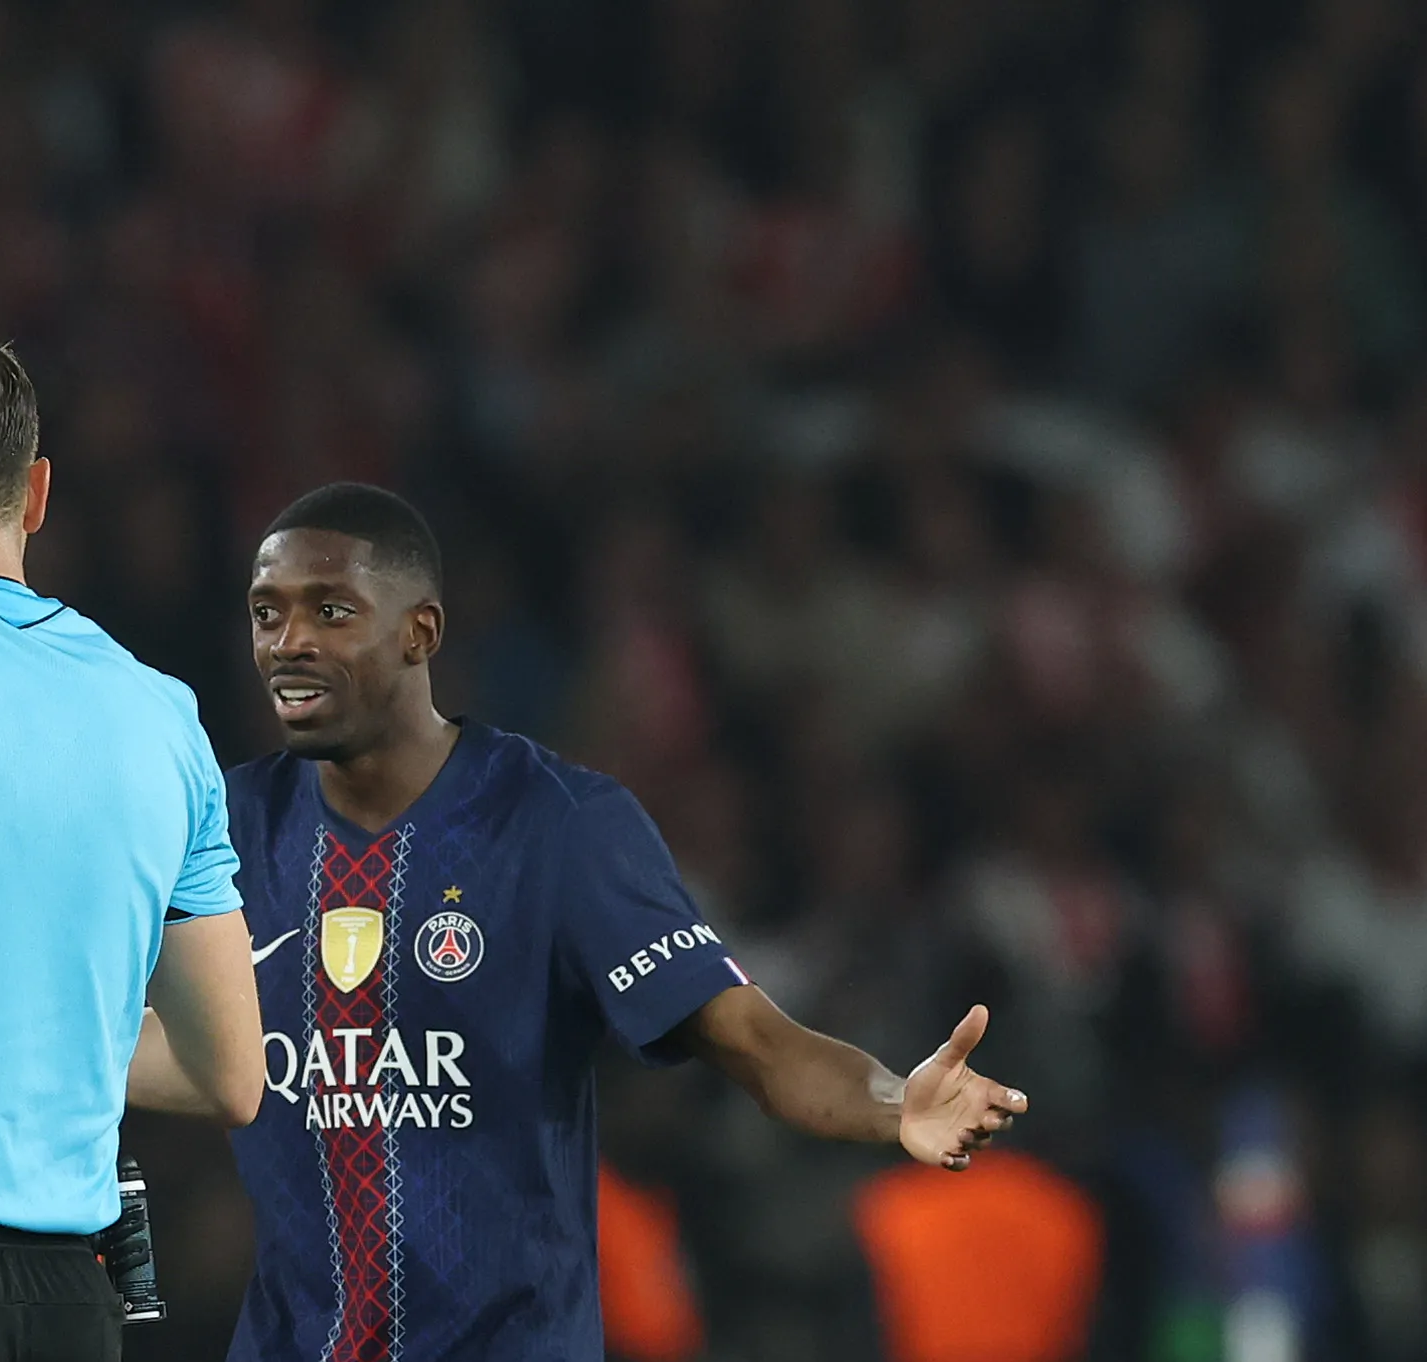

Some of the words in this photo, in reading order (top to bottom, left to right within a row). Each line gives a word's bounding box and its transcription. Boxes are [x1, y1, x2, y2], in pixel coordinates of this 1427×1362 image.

[428, 915, 472, 934] PARIS
[262, 1028, 471, 1104] QATAR
[305, 1093, 474, 1131] AIRWAYS
